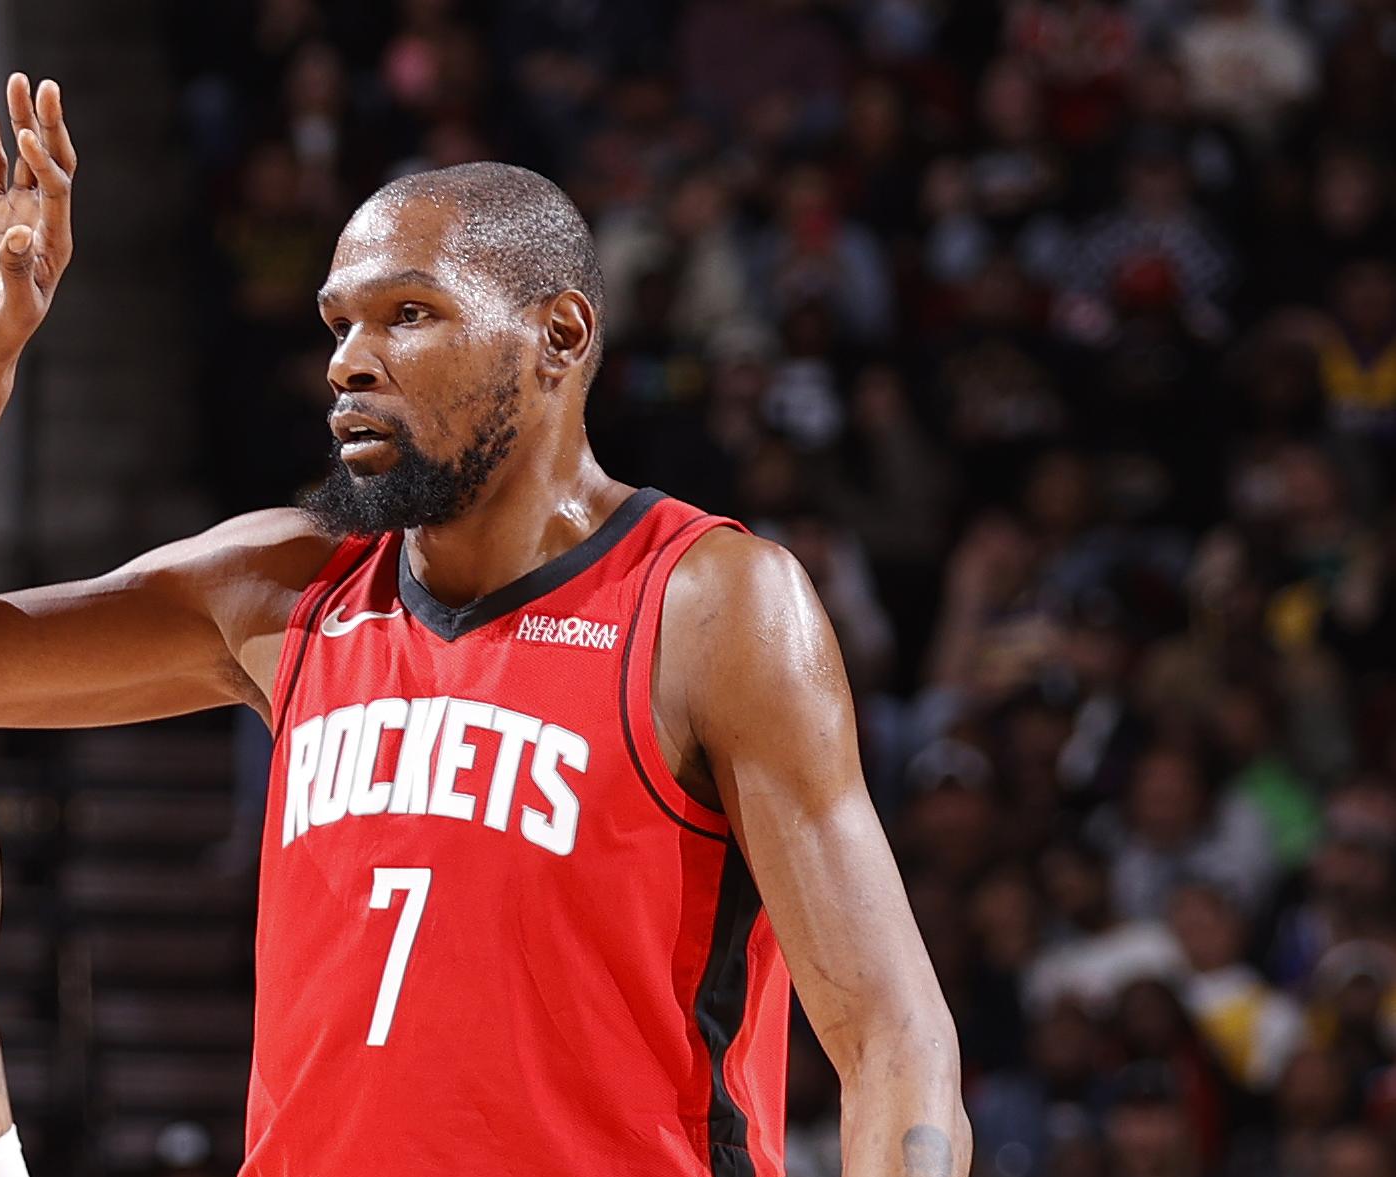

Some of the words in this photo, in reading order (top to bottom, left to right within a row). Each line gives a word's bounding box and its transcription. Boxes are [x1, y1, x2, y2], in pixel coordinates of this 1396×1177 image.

[516, 628, 618, 650] HERMANN
[520, 614, 618, 639] MEMORIAL
[281, 695, 590, 856] ROCKETS
[366, 867, 432, 1047] 7
